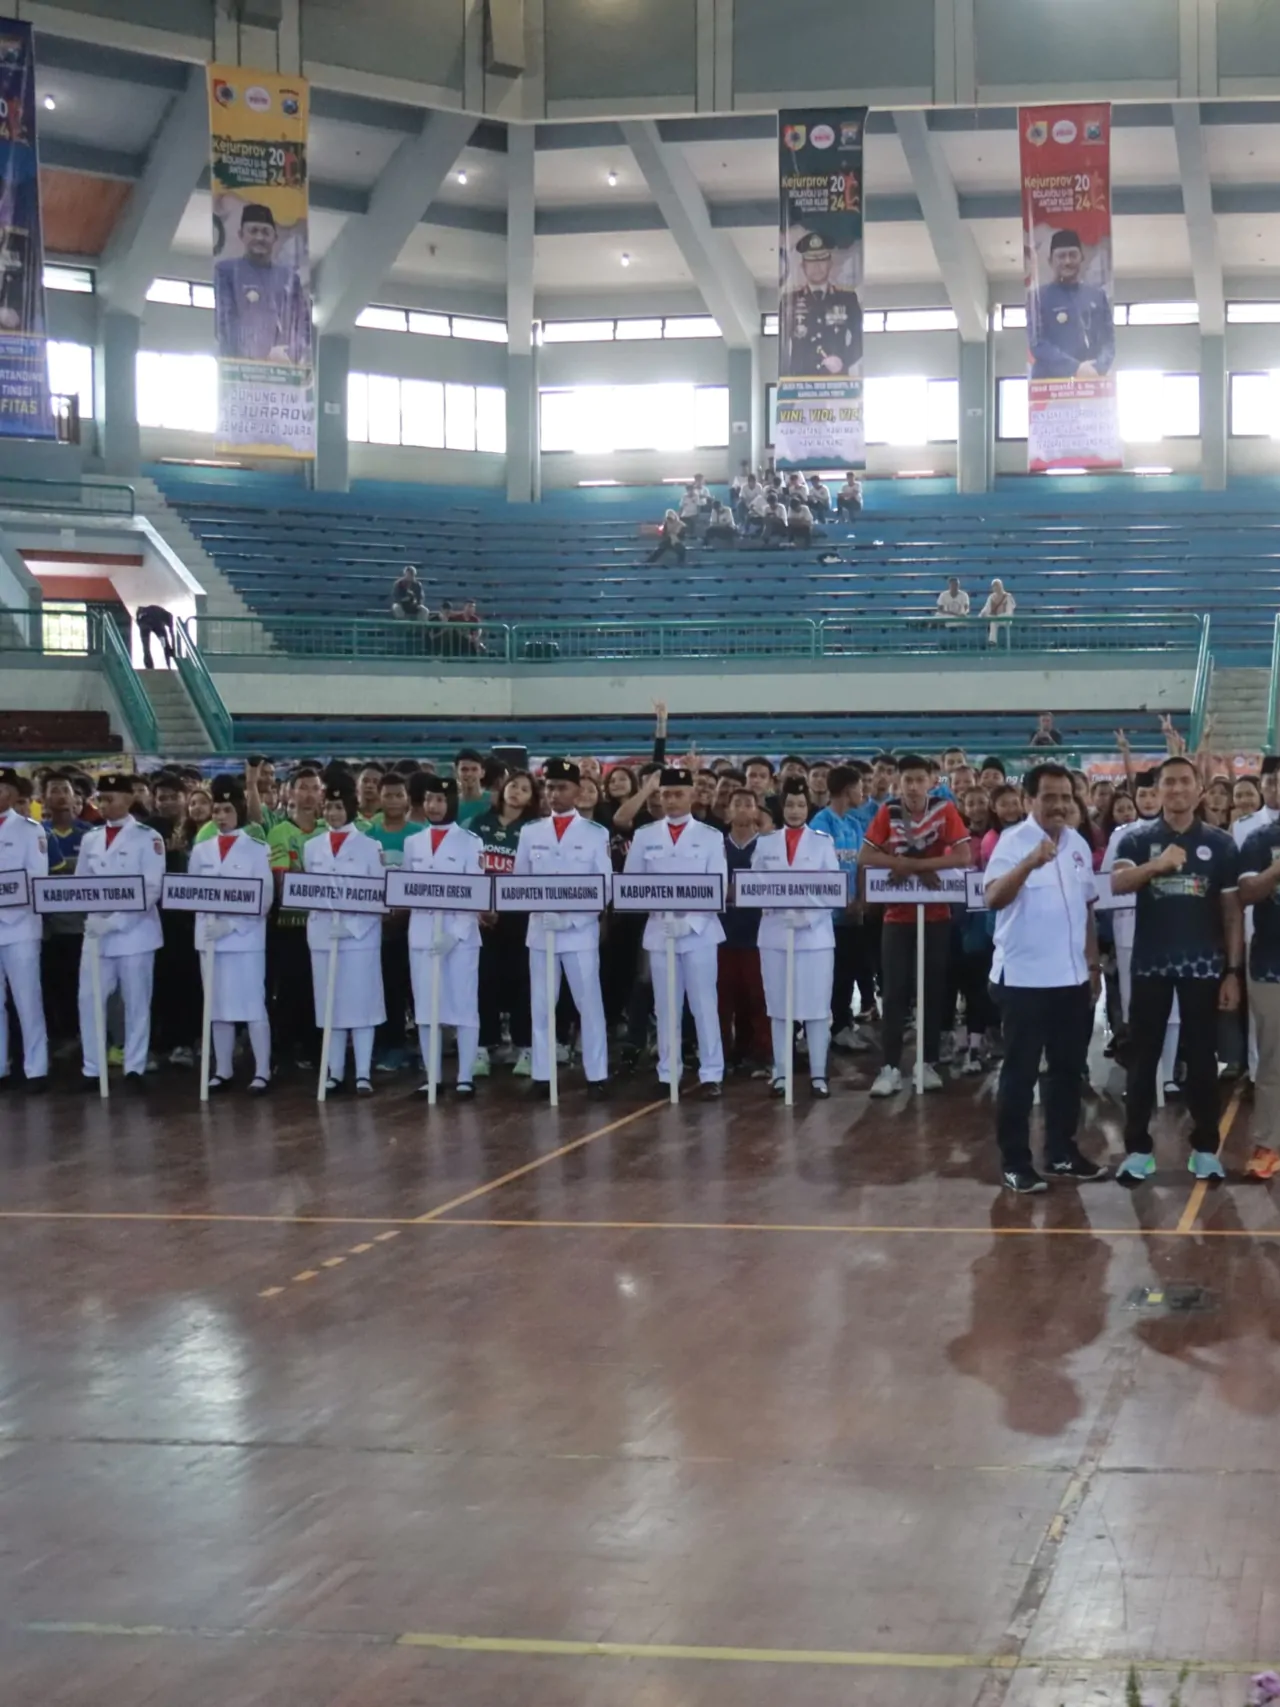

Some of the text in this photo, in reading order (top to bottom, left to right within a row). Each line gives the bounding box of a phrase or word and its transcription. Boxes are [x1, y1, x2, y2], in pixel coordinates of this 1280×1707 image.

[268, 147, 285, 167] 20
[782, 173, 845, 192] Kejurprov 20
[1025, 174, 1090, 191] Kejurprov 20
[485, 854, 513, 872] LUS
[43, 887, 135, 901] KABUPATEN TUBAN
[167, 887, 255, 903] KABUPATEN NGAWI
[289, 884, 385, 902] KABUPATEN PACITAN
[404, 883, 472, 899] KABUPATEN GRESIK
[501, 886, 598, 900] KABUPATEN TULUNGAGUNG
[620, 885, 713, 899] KABUPATEN MADIUN
[741, 883, 842, 896] KABUPATEN BANYUWANGI
